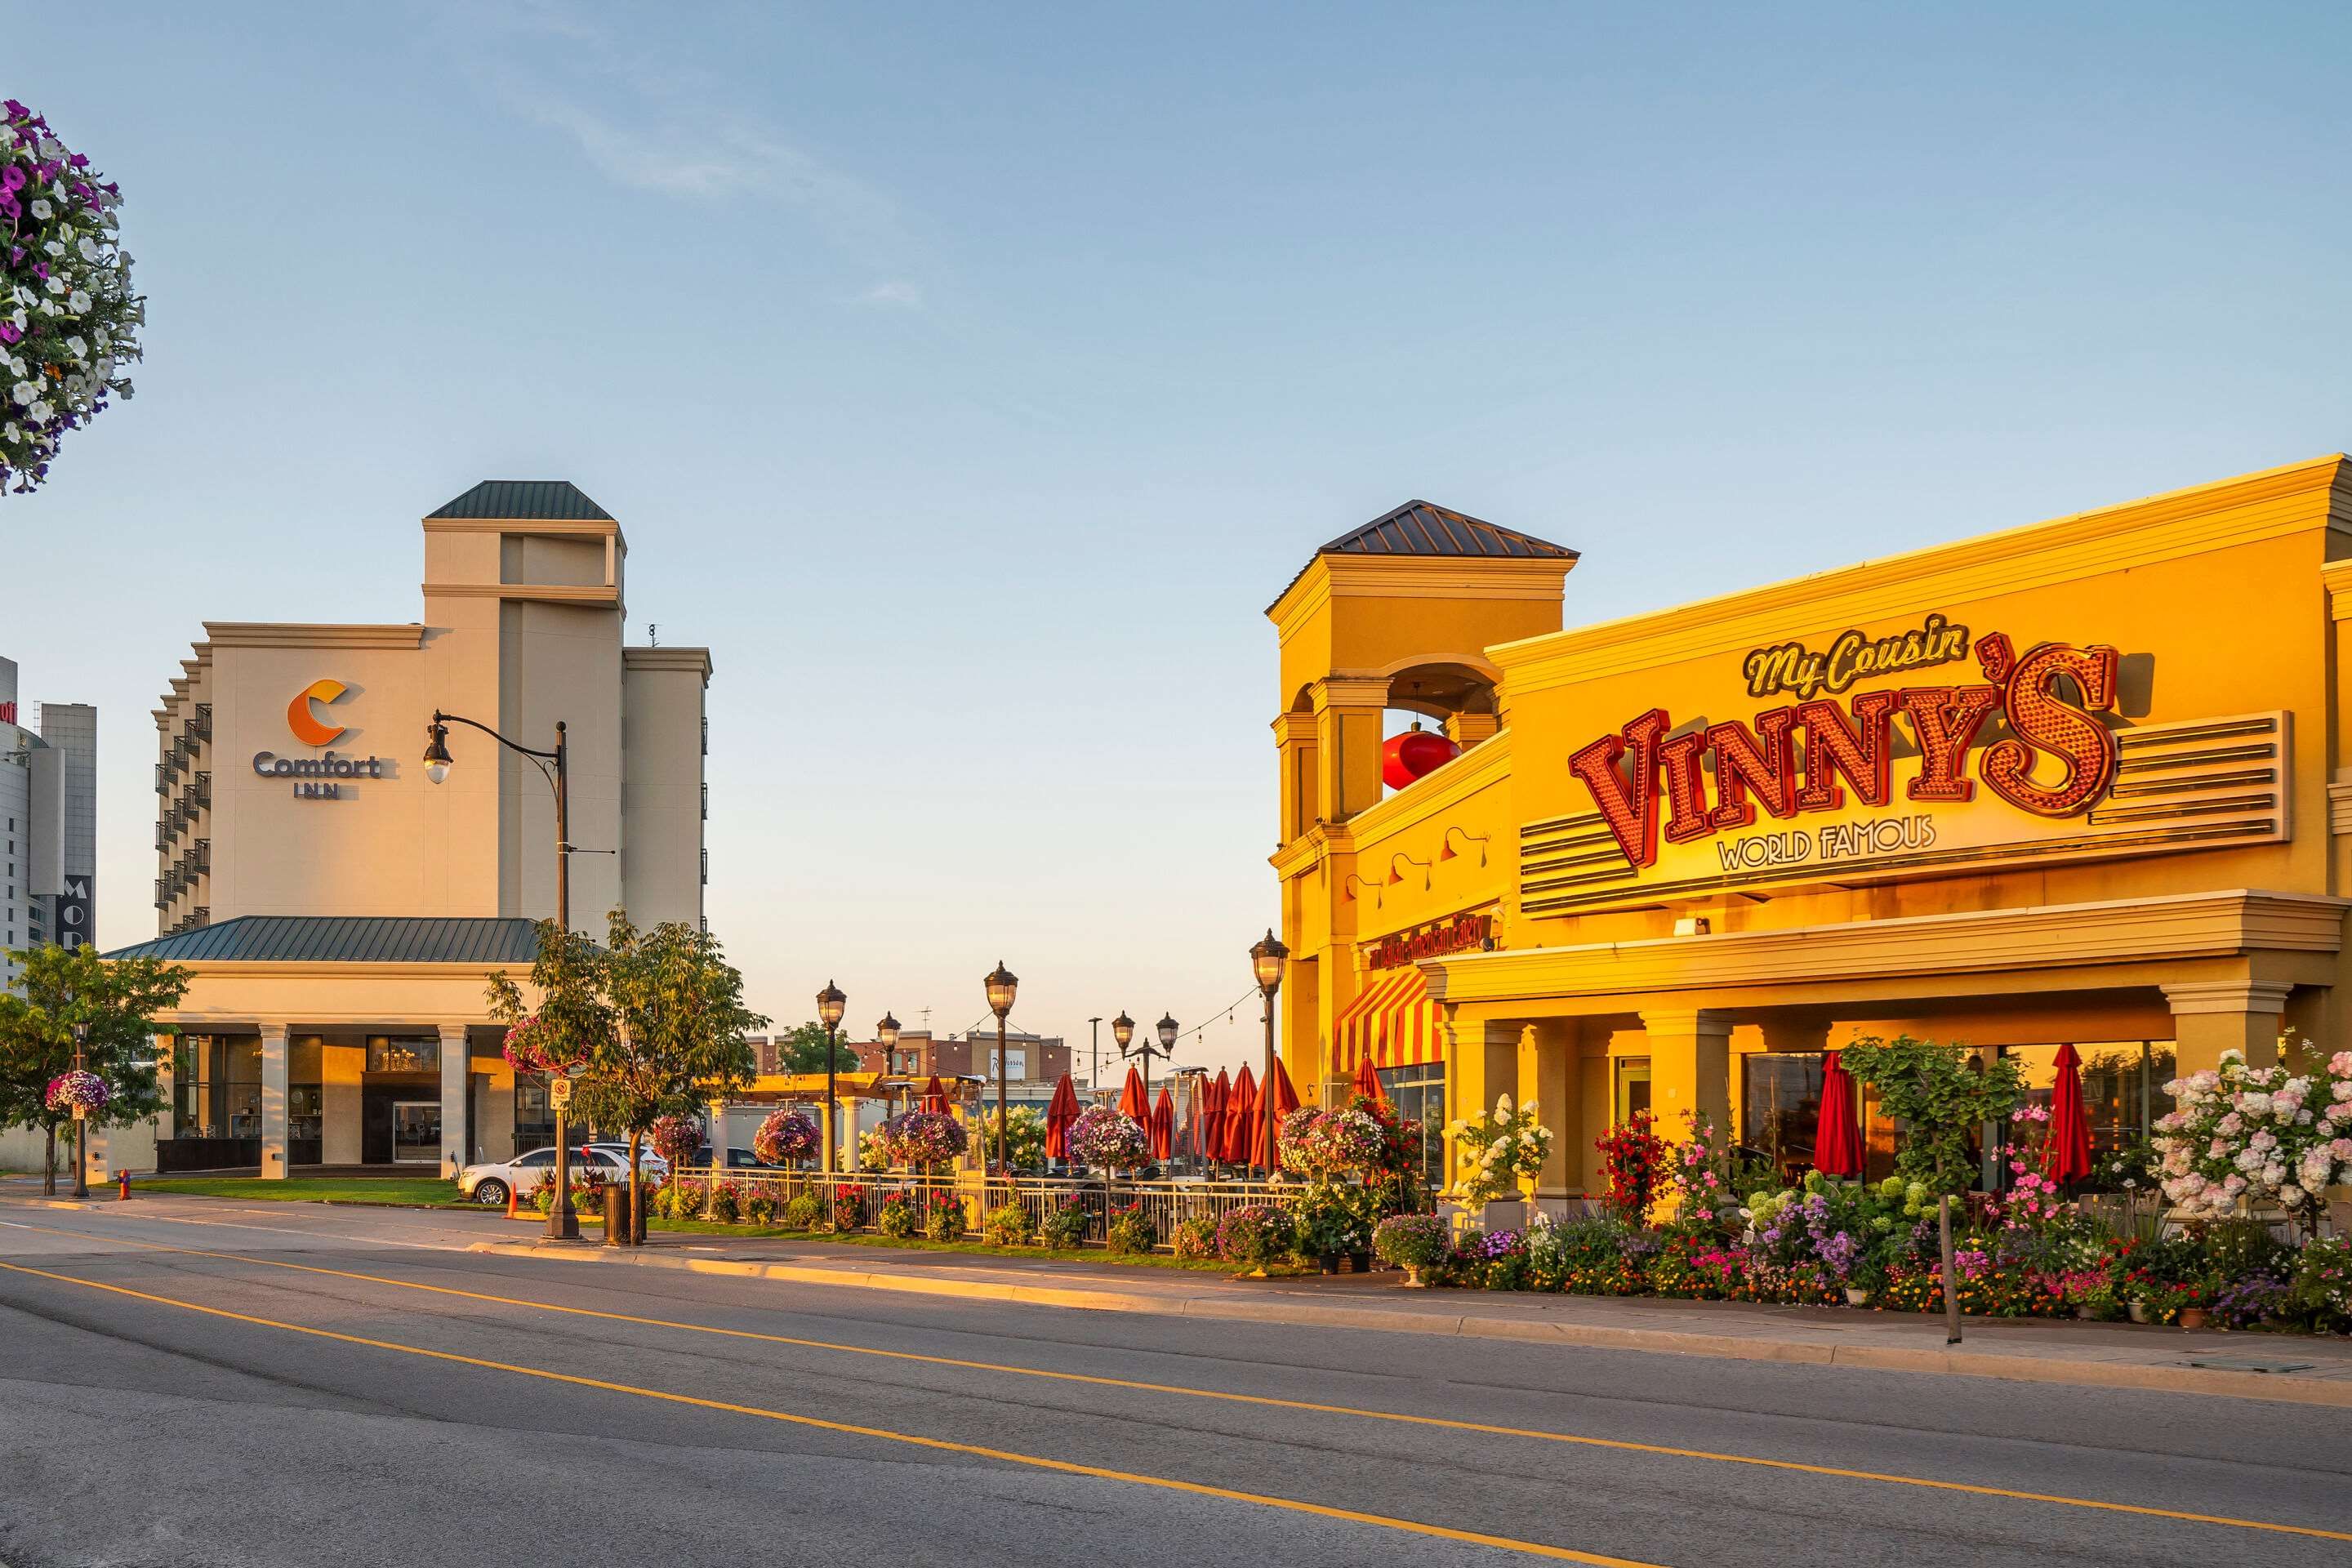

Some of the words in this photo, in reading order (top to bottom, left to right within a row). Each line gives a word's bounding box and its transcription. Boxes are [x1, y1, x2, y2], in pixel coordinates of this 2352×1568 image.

[1745, 644, 1824, 698] My
[1827, 617, 1965, 693] Cousin
[253, 751, 381, 779] Comfort
[1568, 632, 2118, 868] VINNY'S
[294, 782, 340, 800] INN
[1717, 828, 1812, 871] WORLD
[1820, 814, 1936, 860] FAMOUS
